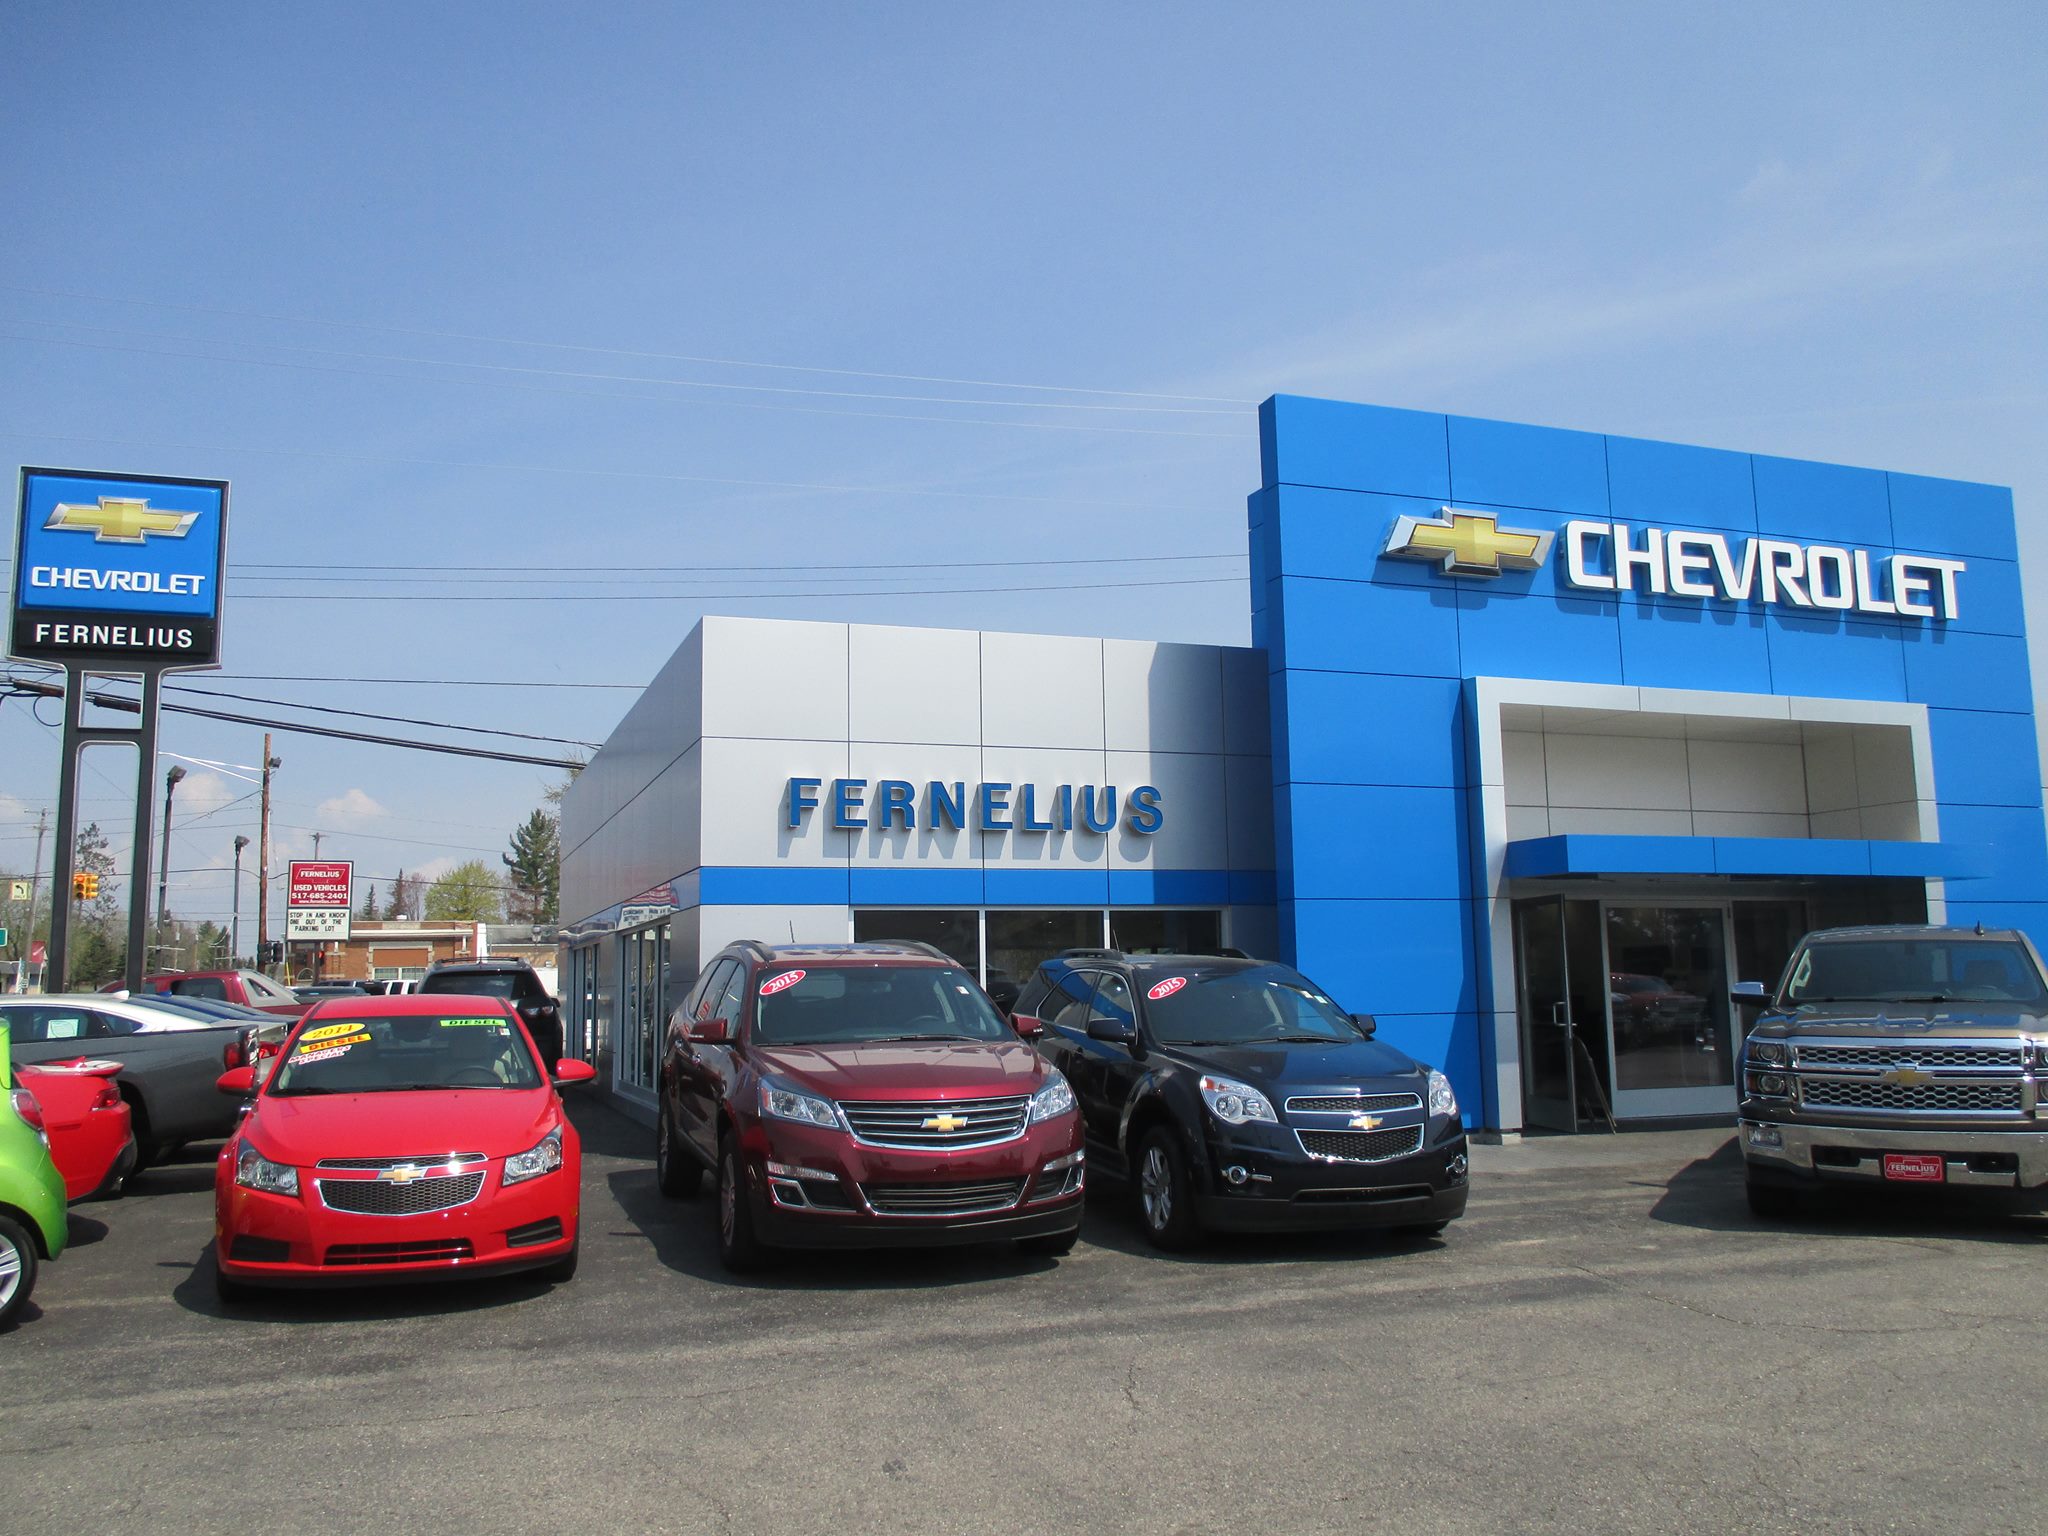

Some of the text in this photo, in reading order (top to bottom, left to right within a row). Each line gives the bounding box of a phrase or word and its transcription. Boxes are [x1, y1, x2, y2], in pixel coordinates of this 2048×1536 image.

[1560, 520, 1966, 620] CHEVROLET
[31, 566, 205, 595] CHEVROLET
[35, 623, 193, 648] FERNELIUS
[786, 777, 1164, 834] FERNELIUS
[300, 870, 340, 878] FERNELIUS
[313, 884, 347, 892] VEHICLES
[768, 972, 799, 992] 2015
[1154, 978, 1181, 996] 2015
[312, 1024, 353, 1039] 2014
[308, 1034, 365, 1051] DIESEL
[1890, 1164, 1935, 1172] FERNELIUS
